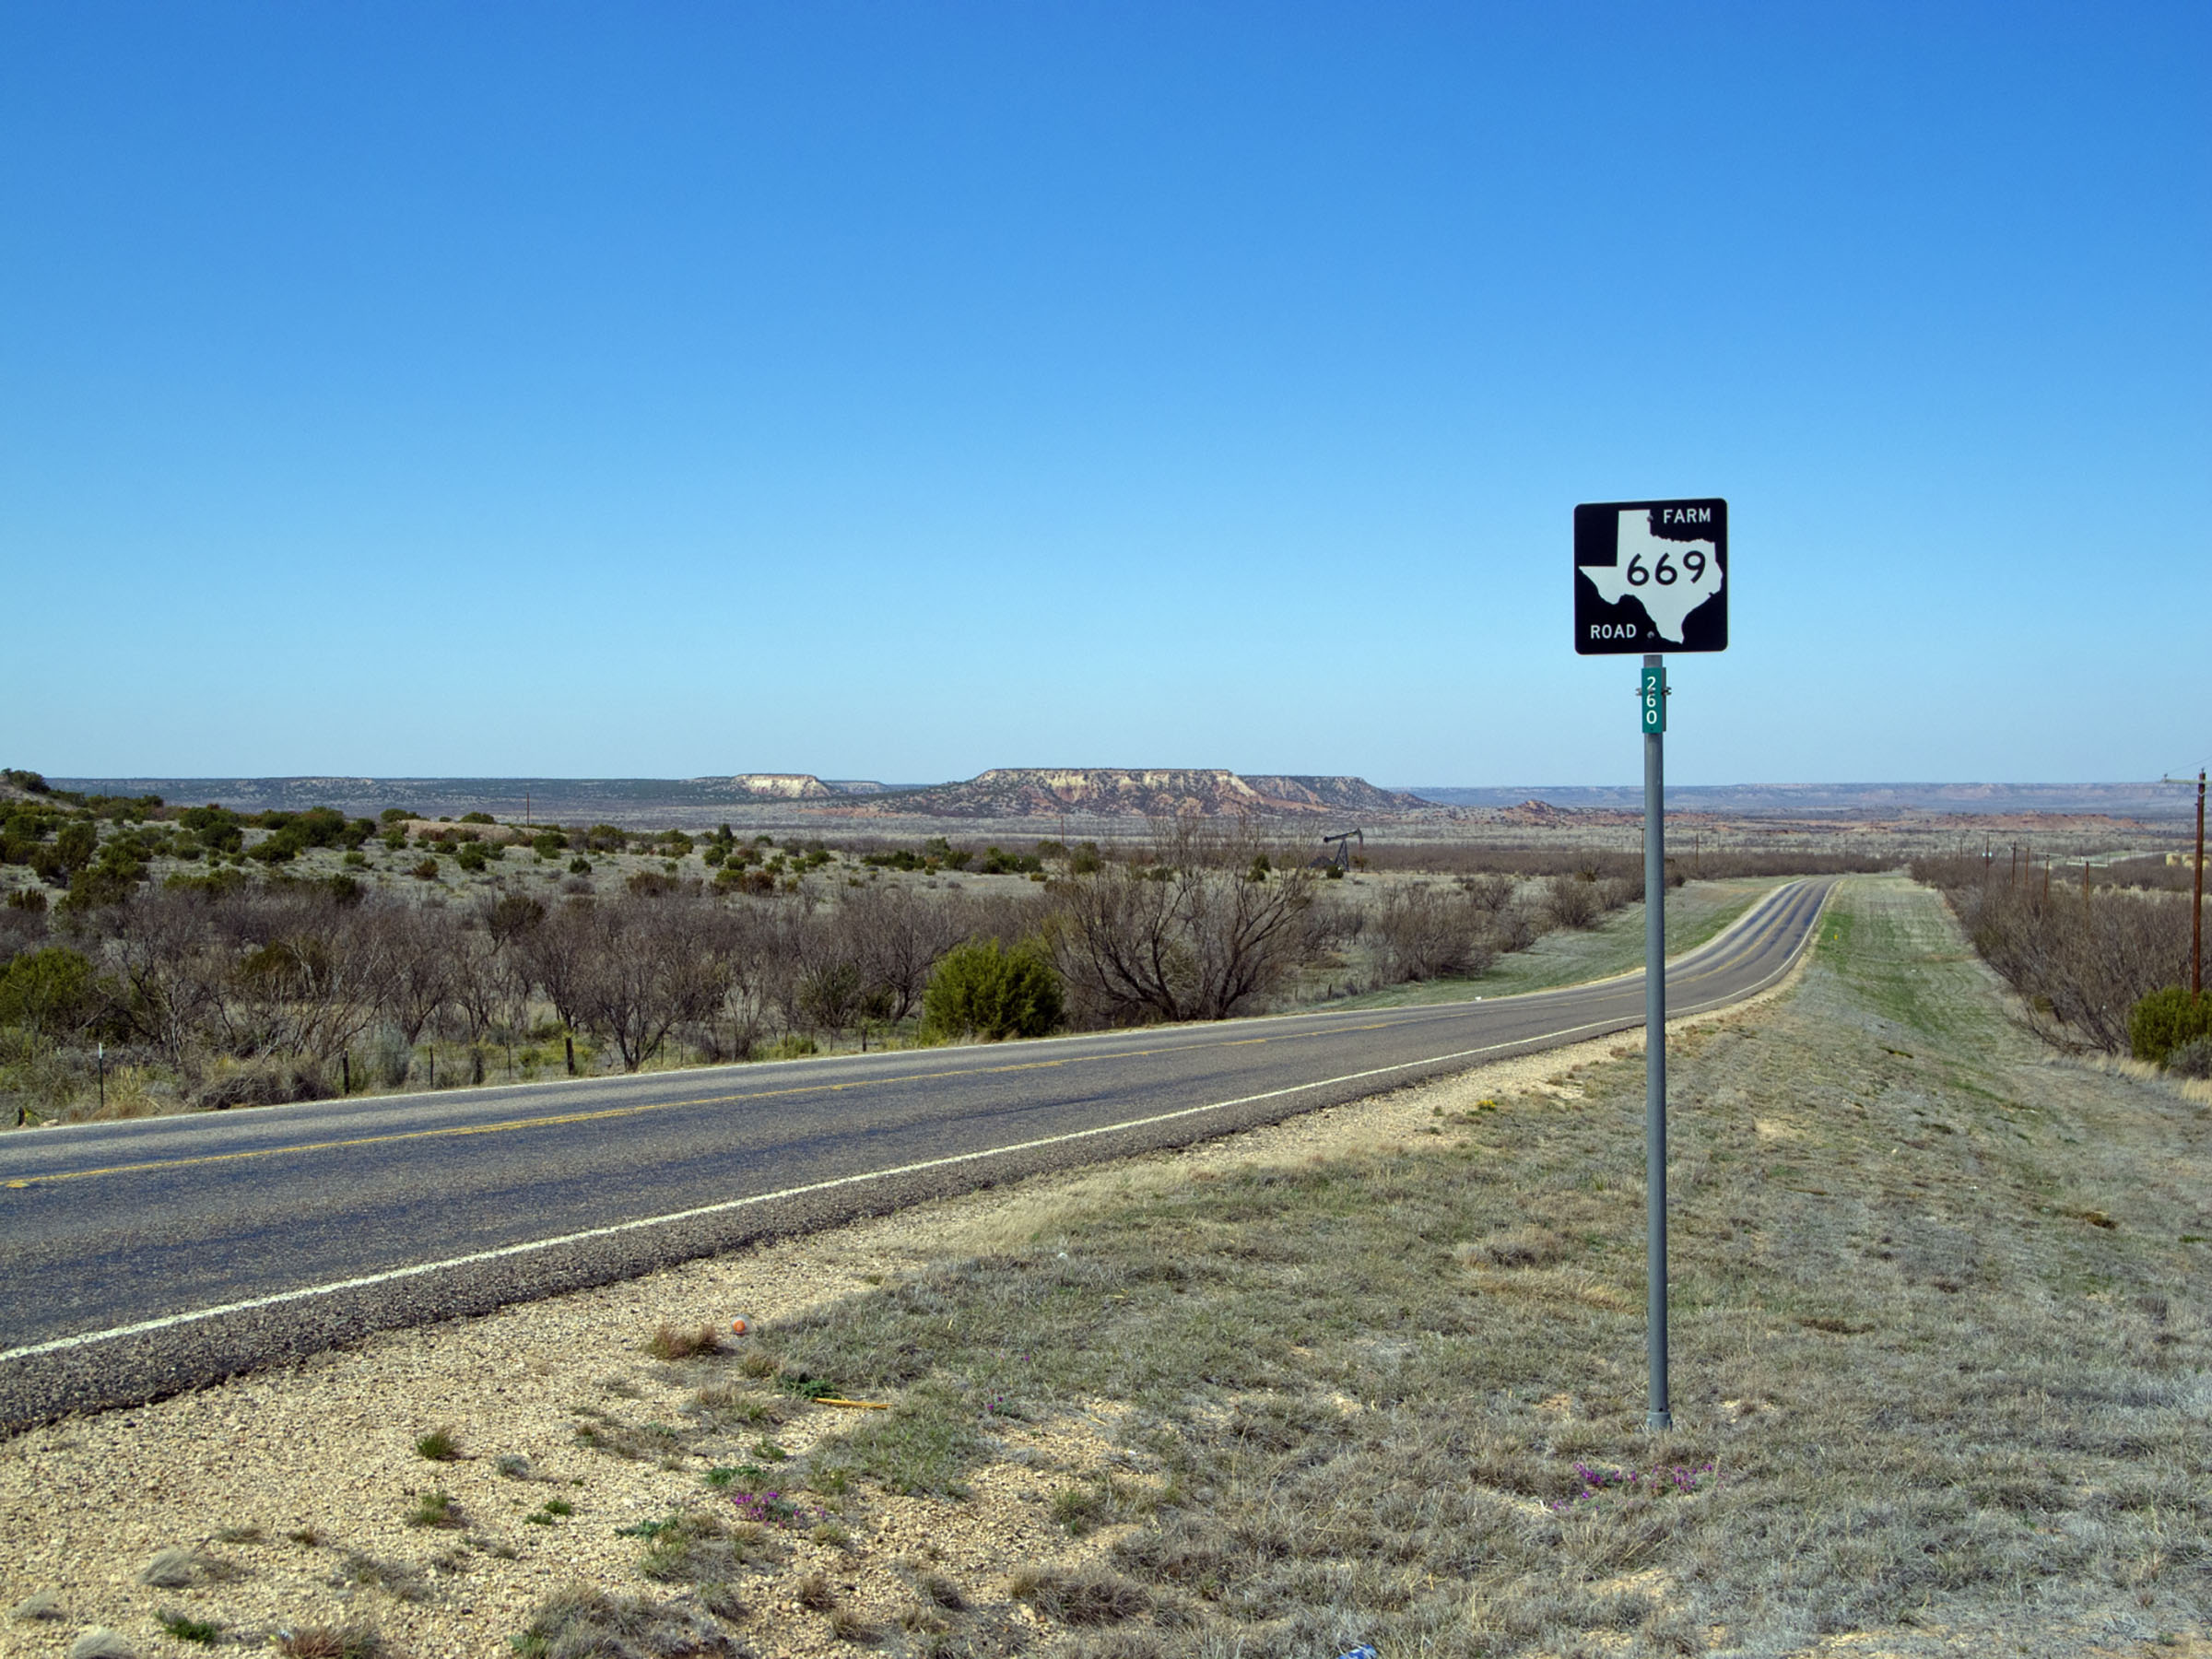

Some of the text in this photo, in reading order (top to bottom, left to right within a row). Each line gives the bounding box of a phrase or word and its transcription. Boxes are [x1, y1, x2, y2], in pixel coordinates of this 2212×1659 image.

[1663, 507, 1712, 524] FARM
[1627, 550, 1706, 586] 669
[1590, 624, 1637, 639] ROAD
